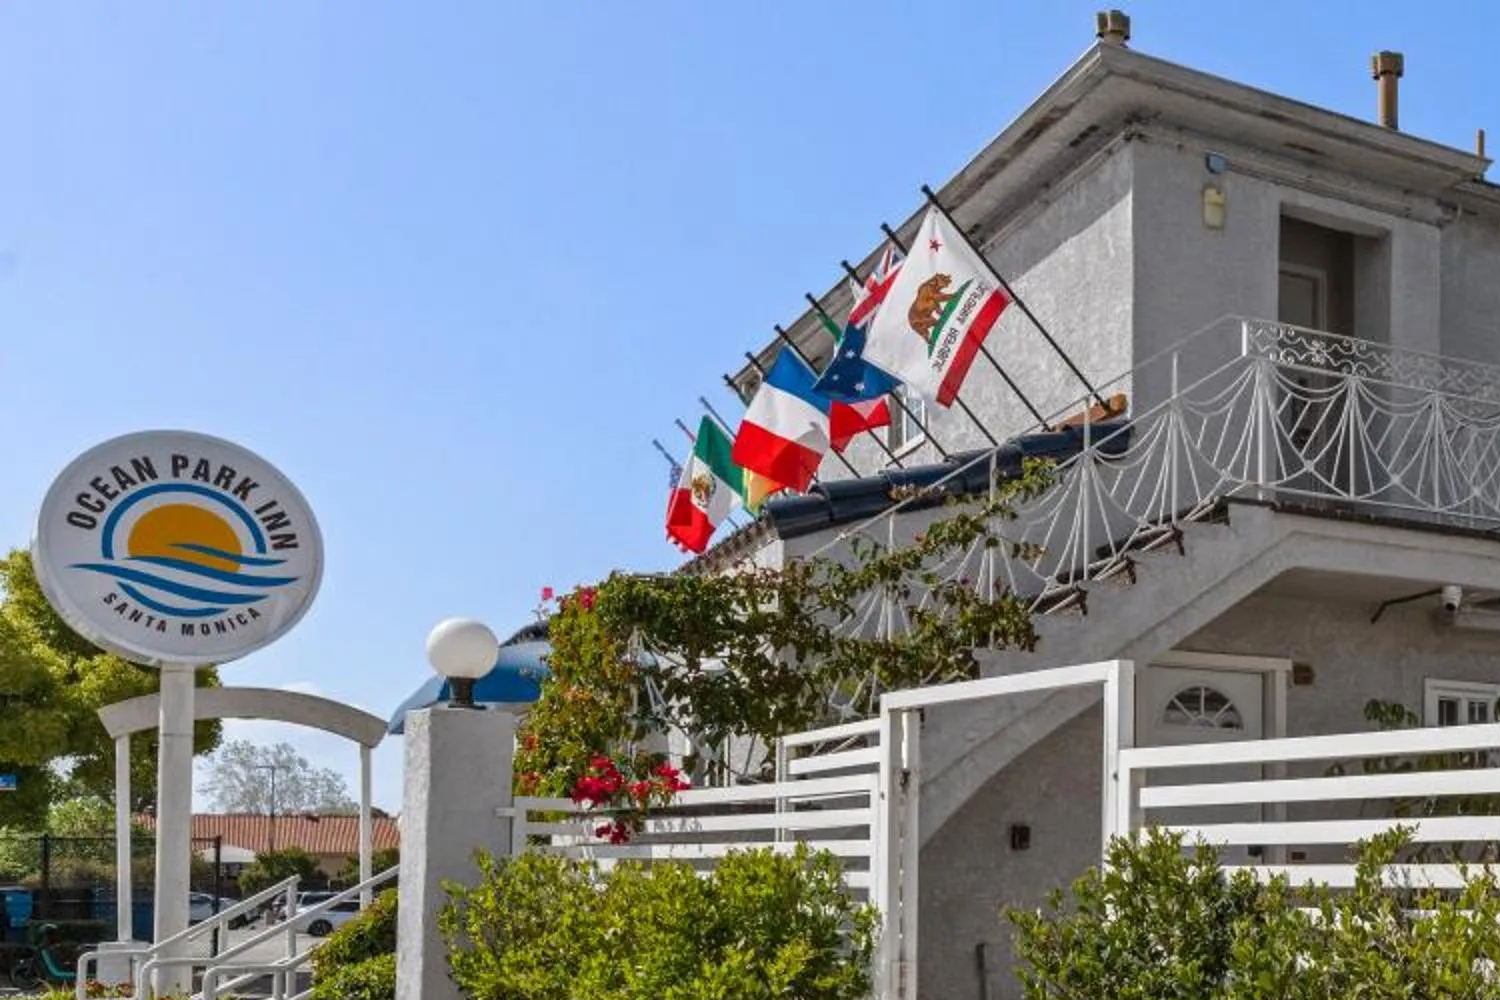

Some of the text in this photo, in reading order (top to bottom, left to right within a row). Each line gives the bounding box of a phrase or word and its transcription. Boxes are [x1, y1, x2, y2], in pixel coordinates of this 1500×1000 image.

[66, 453, 299, 552] OCEAN PARK INN
[103, 592, 262, 637] SANTA MONICA
